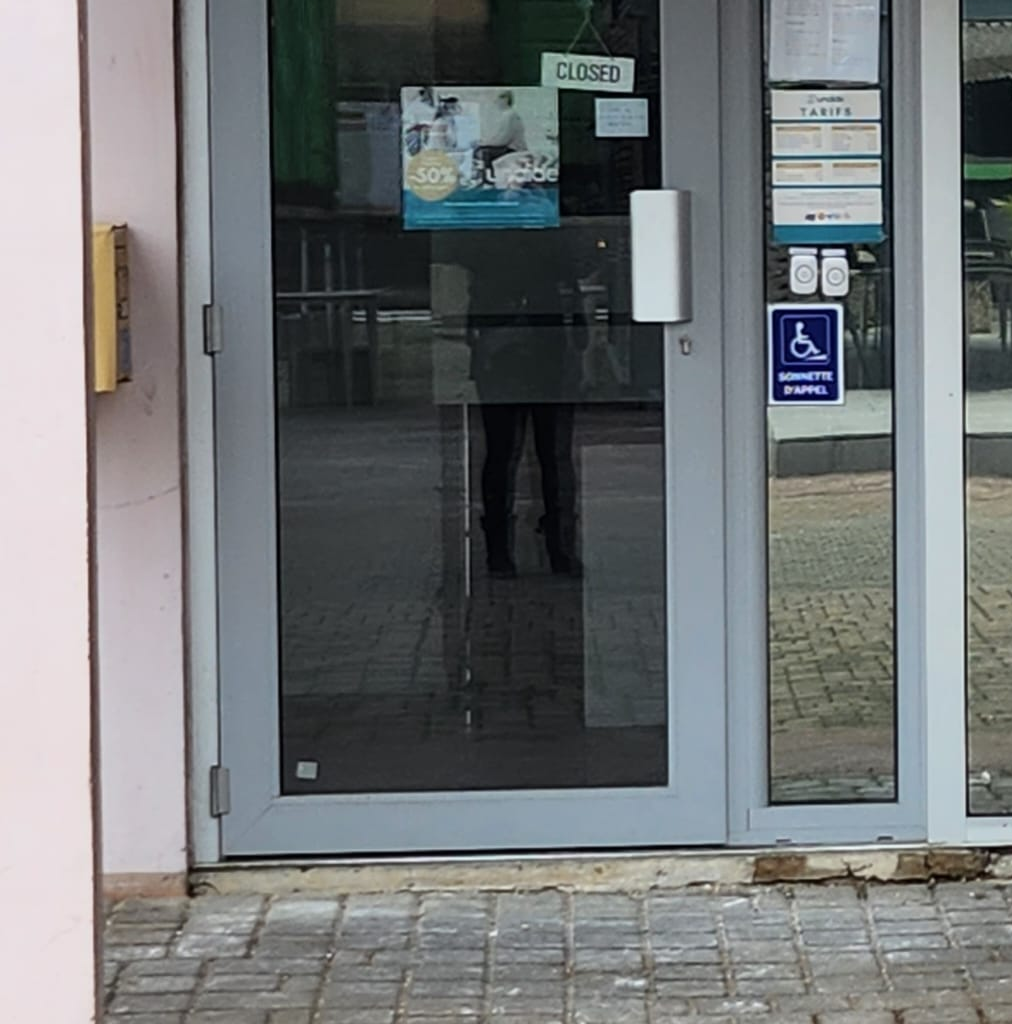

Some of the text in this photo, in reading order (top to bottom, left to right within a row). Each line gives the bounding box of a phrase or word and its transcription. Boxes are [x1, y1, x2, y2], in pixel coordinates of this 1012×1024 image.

[556, 61, 621, 83] CLOSED
[800, 107, 853, 117] TARIFS
[778, 371, 834, 382] SONNETTE
[784, 385, 828, 396] D'APPEL
